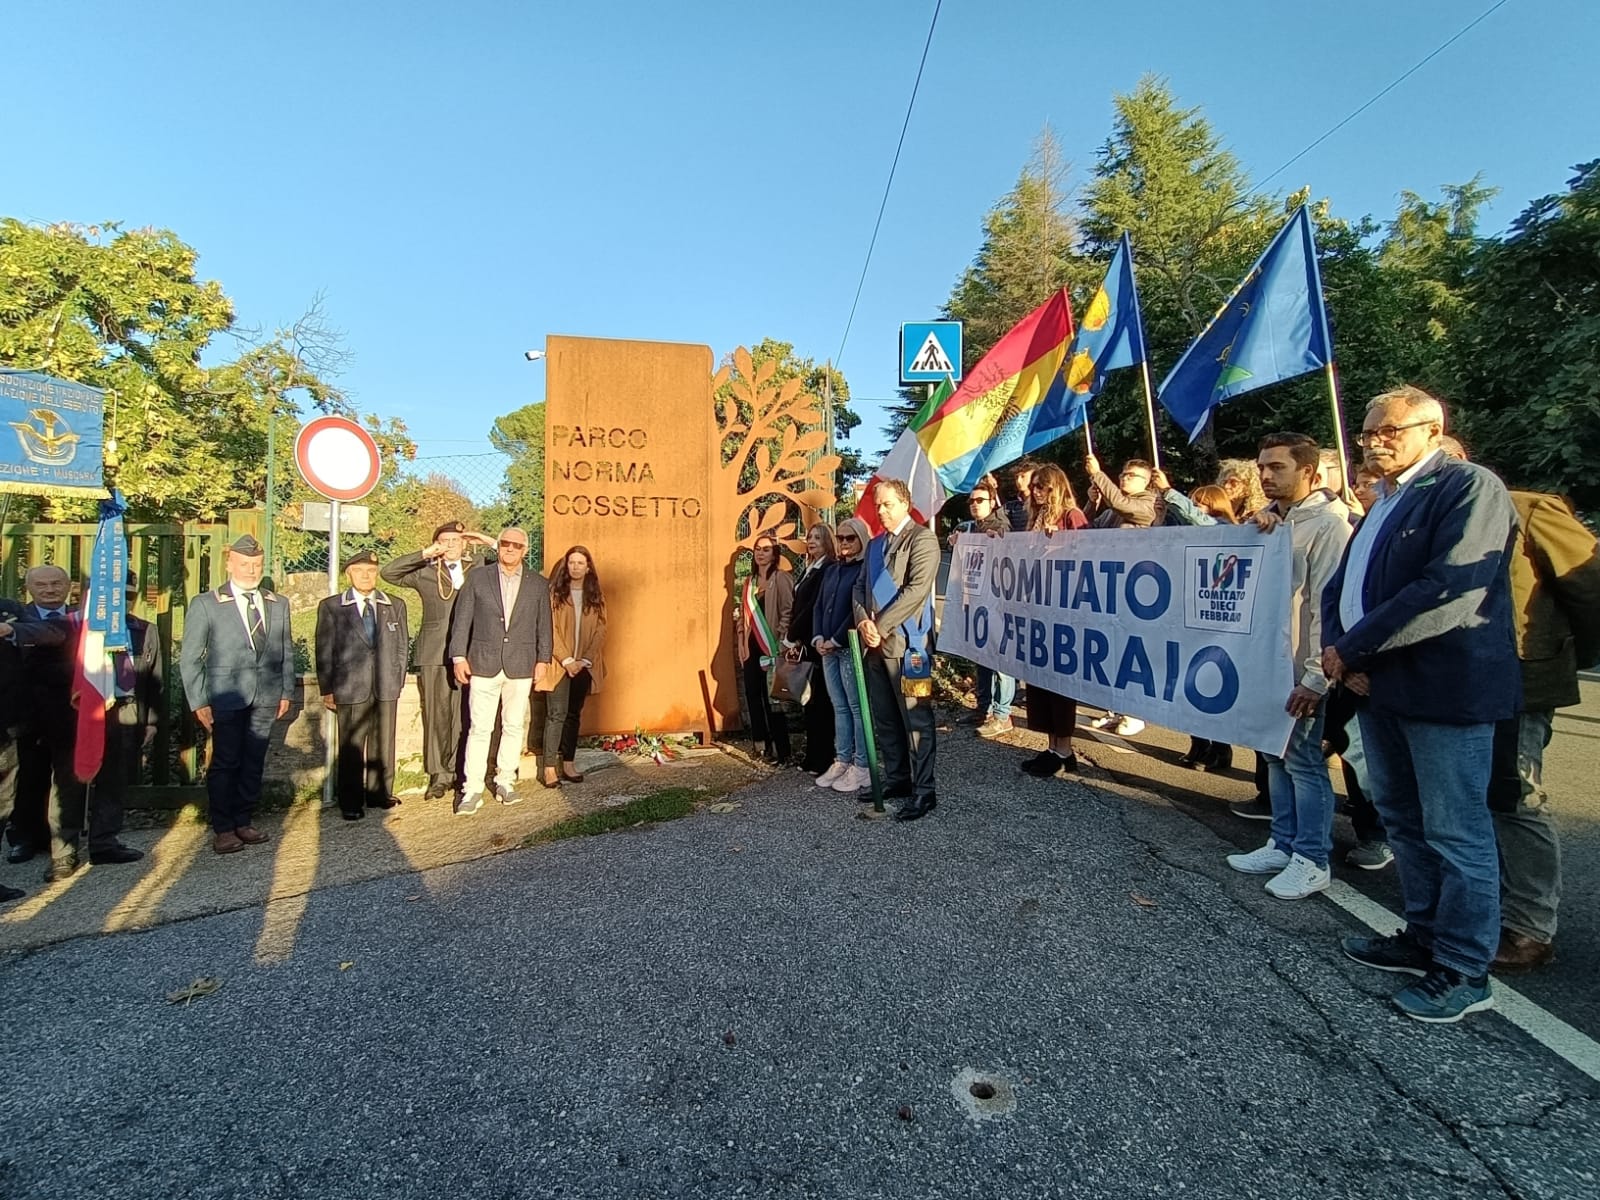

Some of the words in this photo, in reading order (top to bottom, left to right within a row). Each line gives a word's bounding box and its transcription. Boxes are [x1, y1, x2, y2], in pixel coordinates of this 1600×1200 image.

[552, 424, 648, 450] PARCO
[552, 459, 656, 484] NORMA
[552, 494, 701, 518] COSSETTO
[990, 556, 1172, 621] COMITATO
[1198, 589, 1246, 601] COMITATO
[1199, 609, 1242, 622] FEBBRAIO
[1210, 600, 1236, 612] DIECI
[964, 604, 989, 649] 10
[1000, 612, 1240, 715] FEBBRAIO
